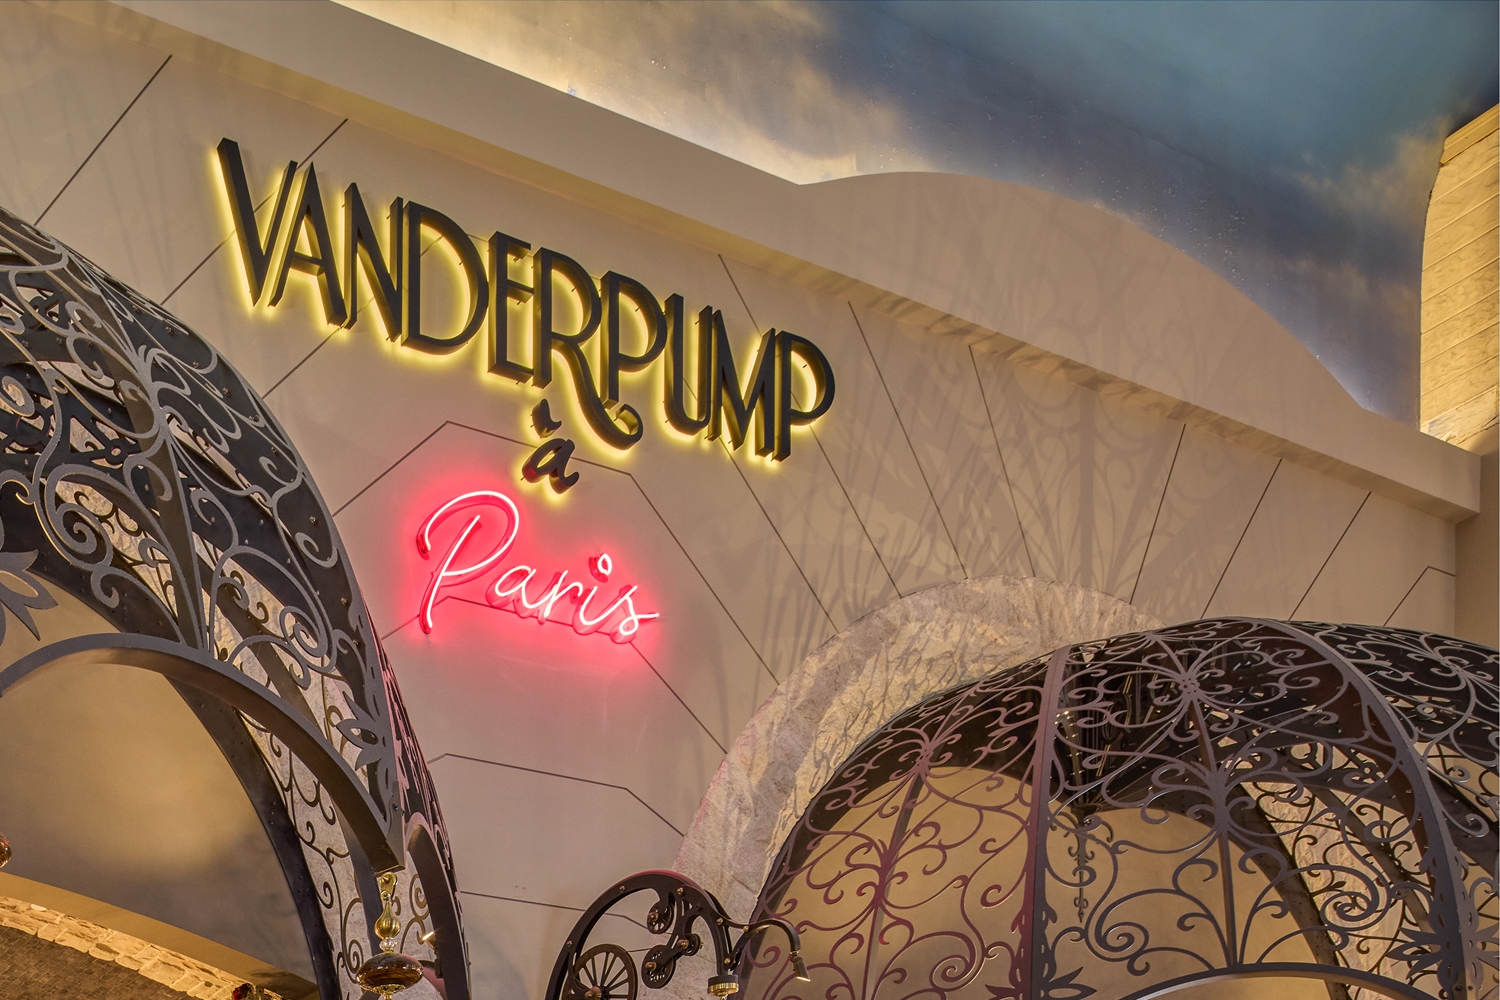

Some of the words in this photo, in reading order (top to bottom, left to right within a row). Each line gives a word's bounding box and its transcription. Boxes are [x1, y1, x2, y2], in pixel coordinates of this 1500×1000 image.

[216, 137, 836, 461] VANDERPUMP
[521, 399, 580, 494] à
[418, 490, 659, 641] Paris
